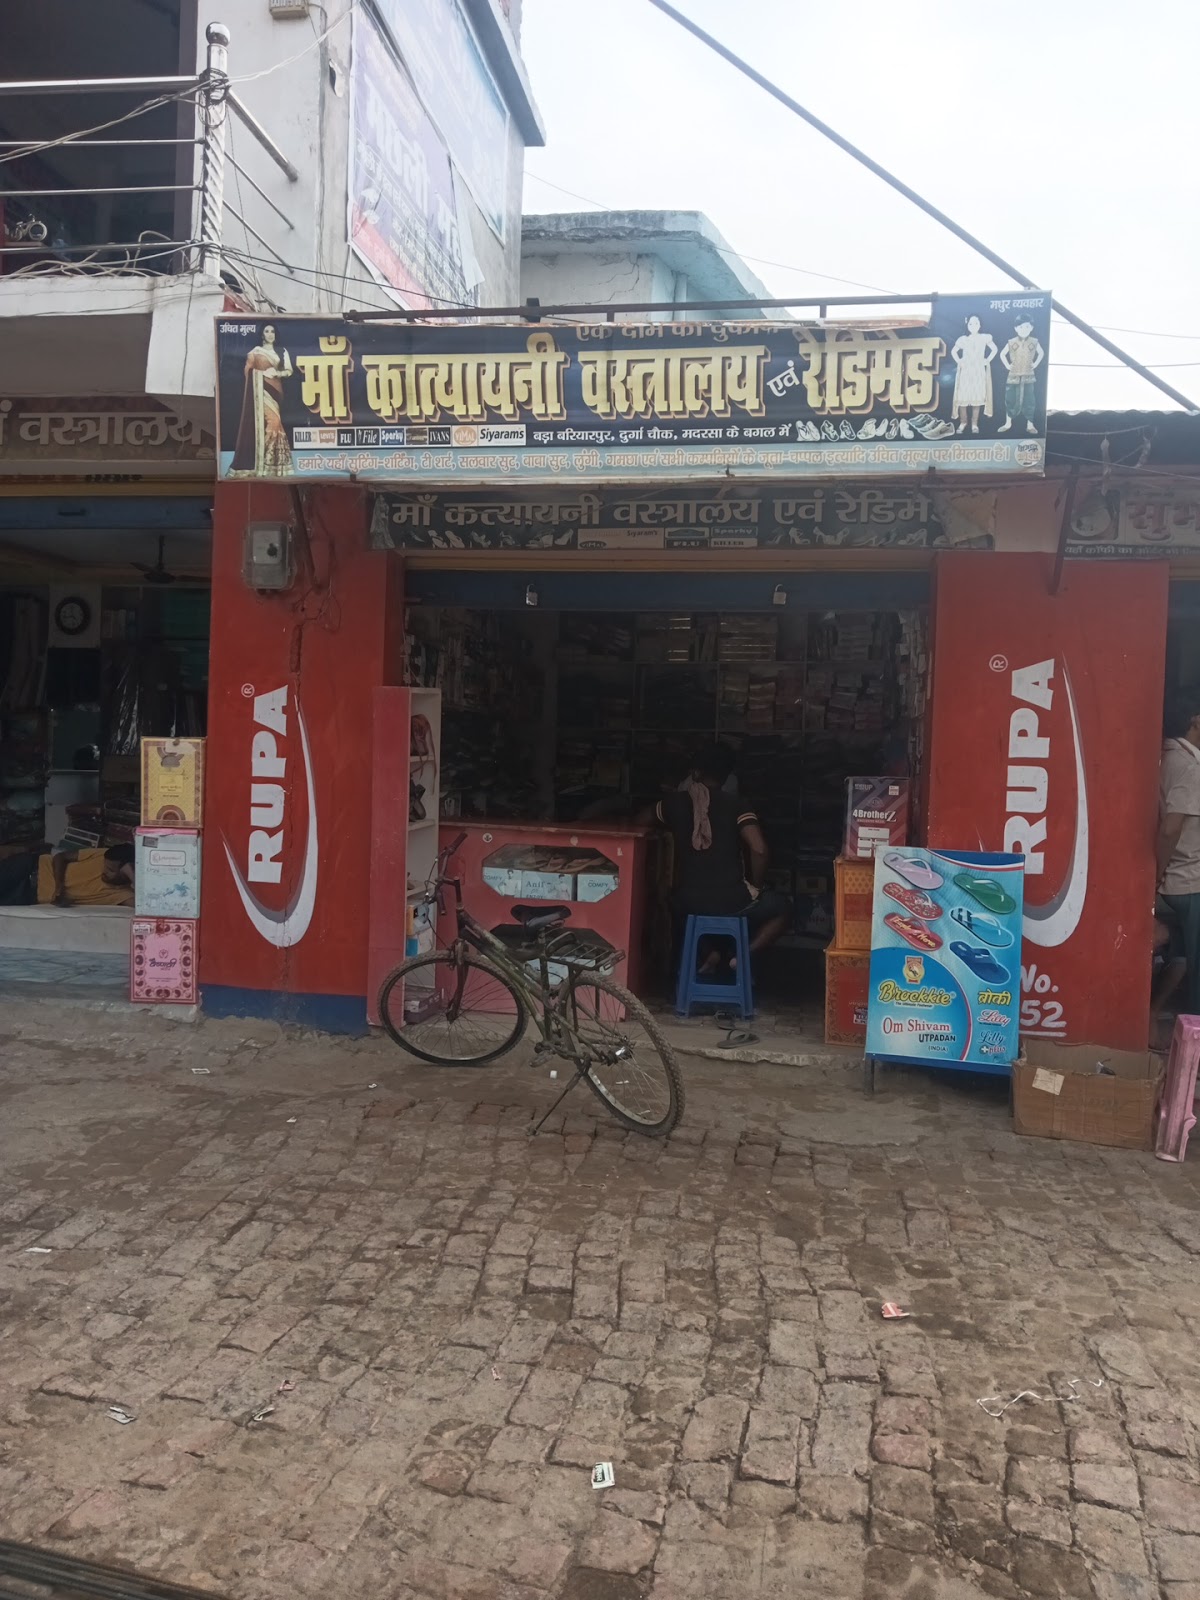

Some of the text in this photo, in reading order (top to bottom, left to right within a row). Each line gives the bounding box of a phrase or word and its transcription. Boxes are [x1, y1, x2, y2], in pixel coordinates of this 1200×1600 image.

[990, 300, 1011, 312] मधुर
[219, 322, 239, 333] उचित
[296, 335, 355, 424] माँ
[361, 332, 570, 424] कात्यायनी
[766, 360, 801, 397] एवं
[619, 426, 643, 443] दुर्गा
[647, 425, 678, 441] चौक,
[682, 428, 722, 439] मदरसा
[726, 425, 739, 438] के
[743, 427, 776, 438] बगल
[776, 424, 792, 437] में
[298, 453, 324, 471] हमारे
[459, 454, 496, 469] सलवार
[640, 447, 658, 468] एवं
[660, 448, 685, 468] सभी
[742, 447, 756, 466] के
[868, 444, 899, 464] उचित
[932, 447, 950, 463] पर
[950, 443, 991, 463] मिलता
[392, 493, 438, 526] माँ
[773, 488, 825, 524] एवं
[834, 489, 940, 524] रेडिमे
[1004, 658, 1055, 874] RUPA
[248, 684, 288, 883] RUPA
[1020, 963, 1059, 993] No.
[883, 1016, 950, 1035] Om Shivam
[918, 1033, 956, 1043] UTPADAN
